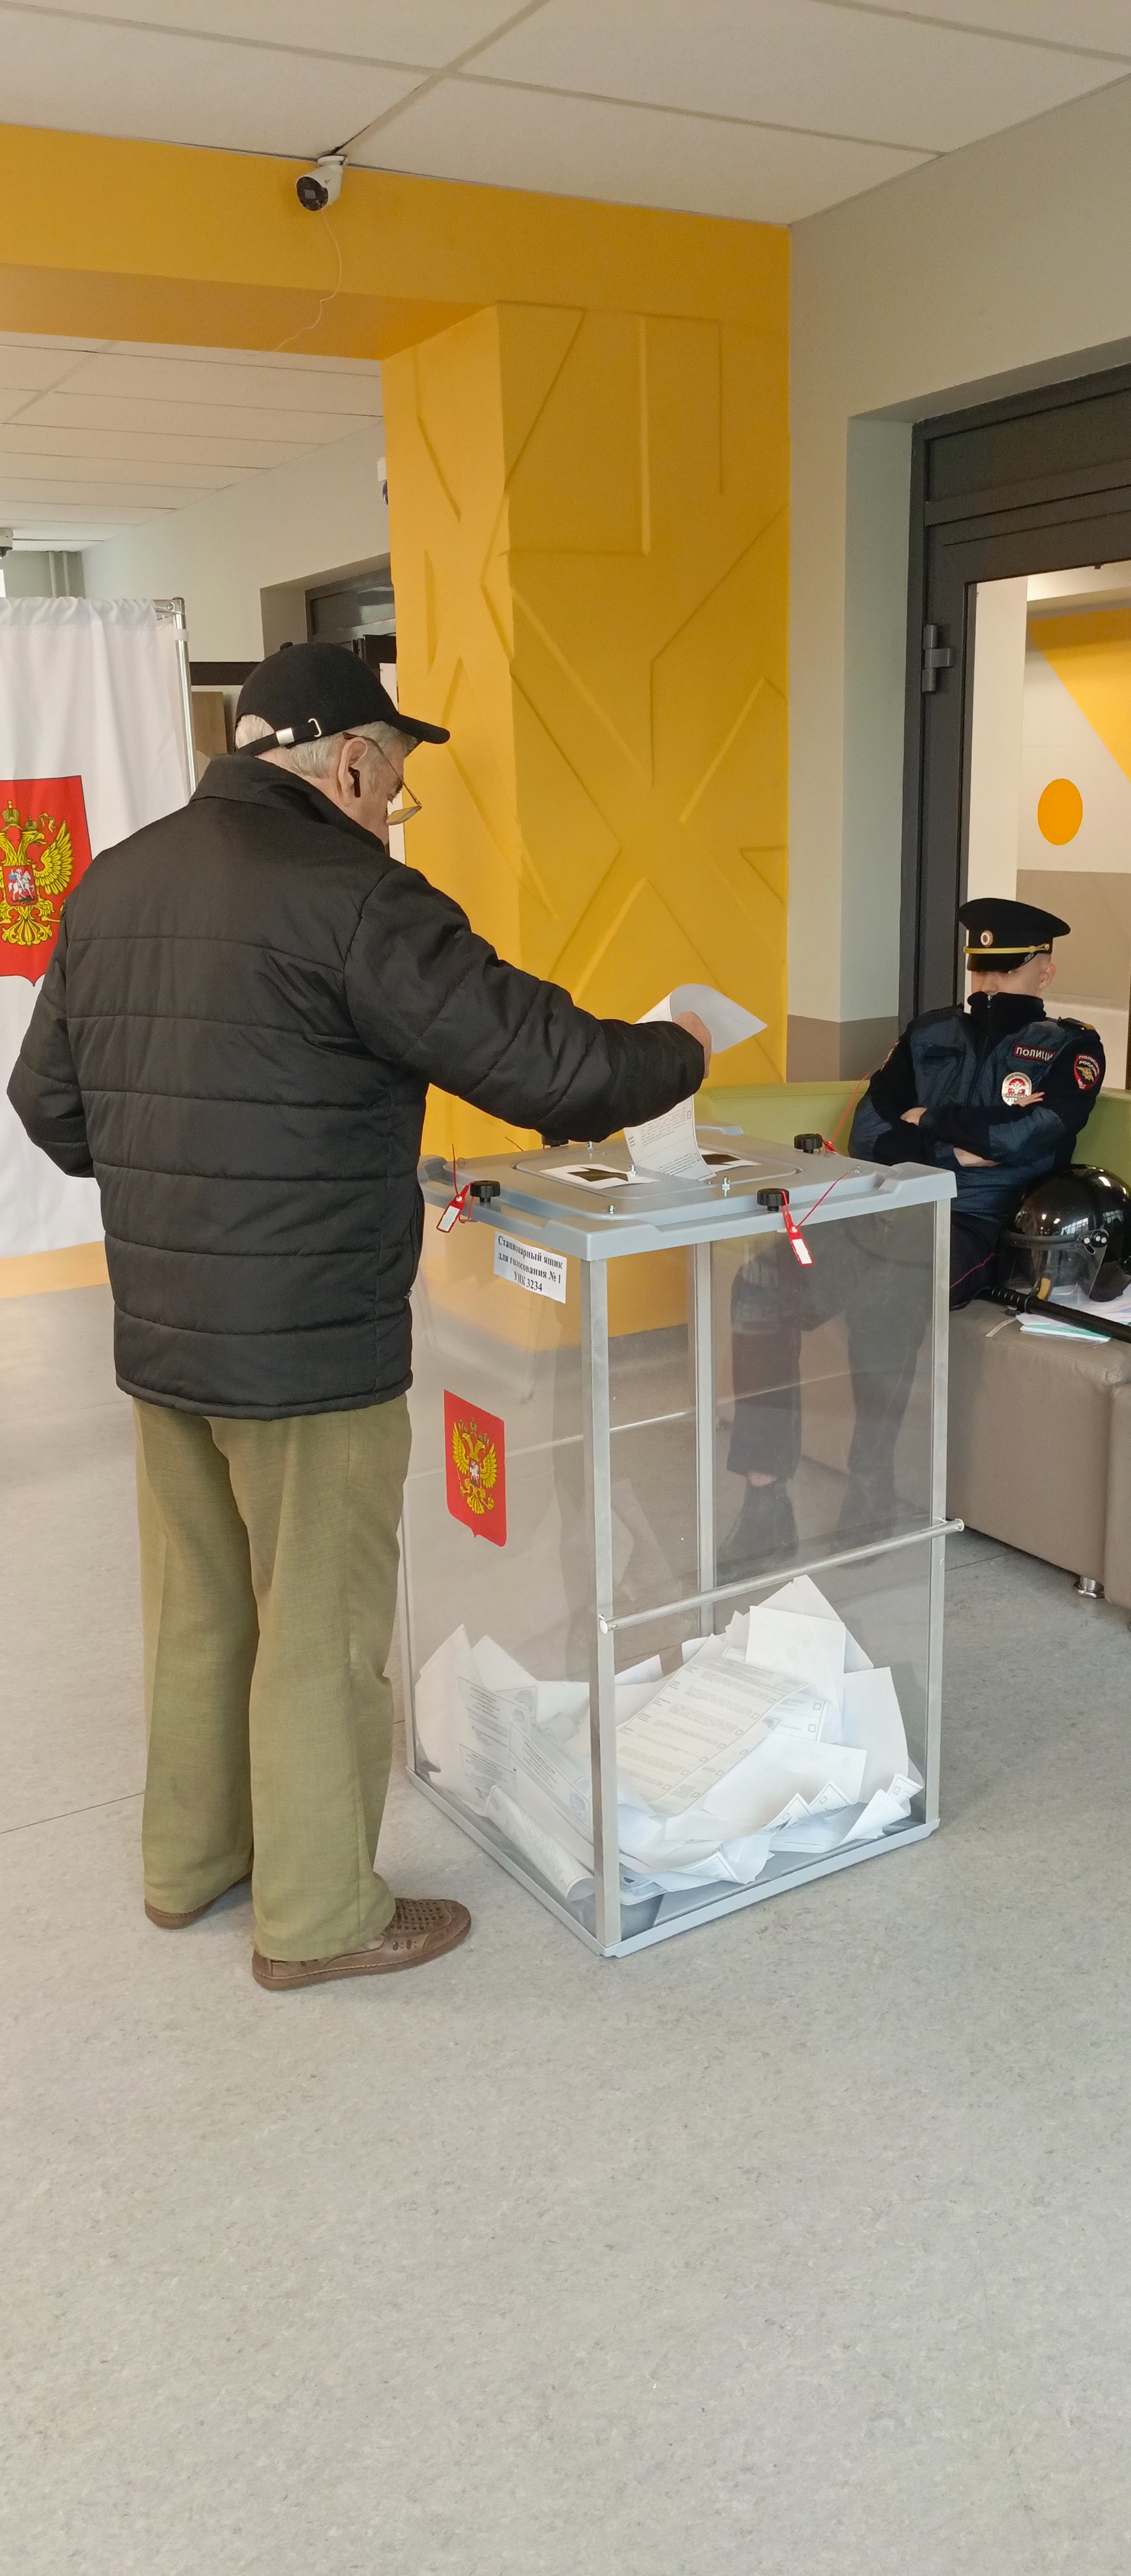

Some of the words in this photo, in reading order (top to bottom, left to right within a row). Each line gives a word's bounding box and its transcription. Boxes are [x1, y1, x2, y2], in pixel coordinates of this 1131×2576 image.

[1016, 1047, 1053, 1061] ПОЛИЦИ
[498, 1235, 542, 1262] Стационарный
[544, 1256, 563, 1269] ящик
[498, 1252, 509, 1263] для
[509, 1259, 547, 1279] голосования
[548, 1271, 557, 1282] №
[558, 1274, 561, 1284] 1
[514, 1271, 526, 1286] УИК
[526, 1278, 542, 1292] 3234
